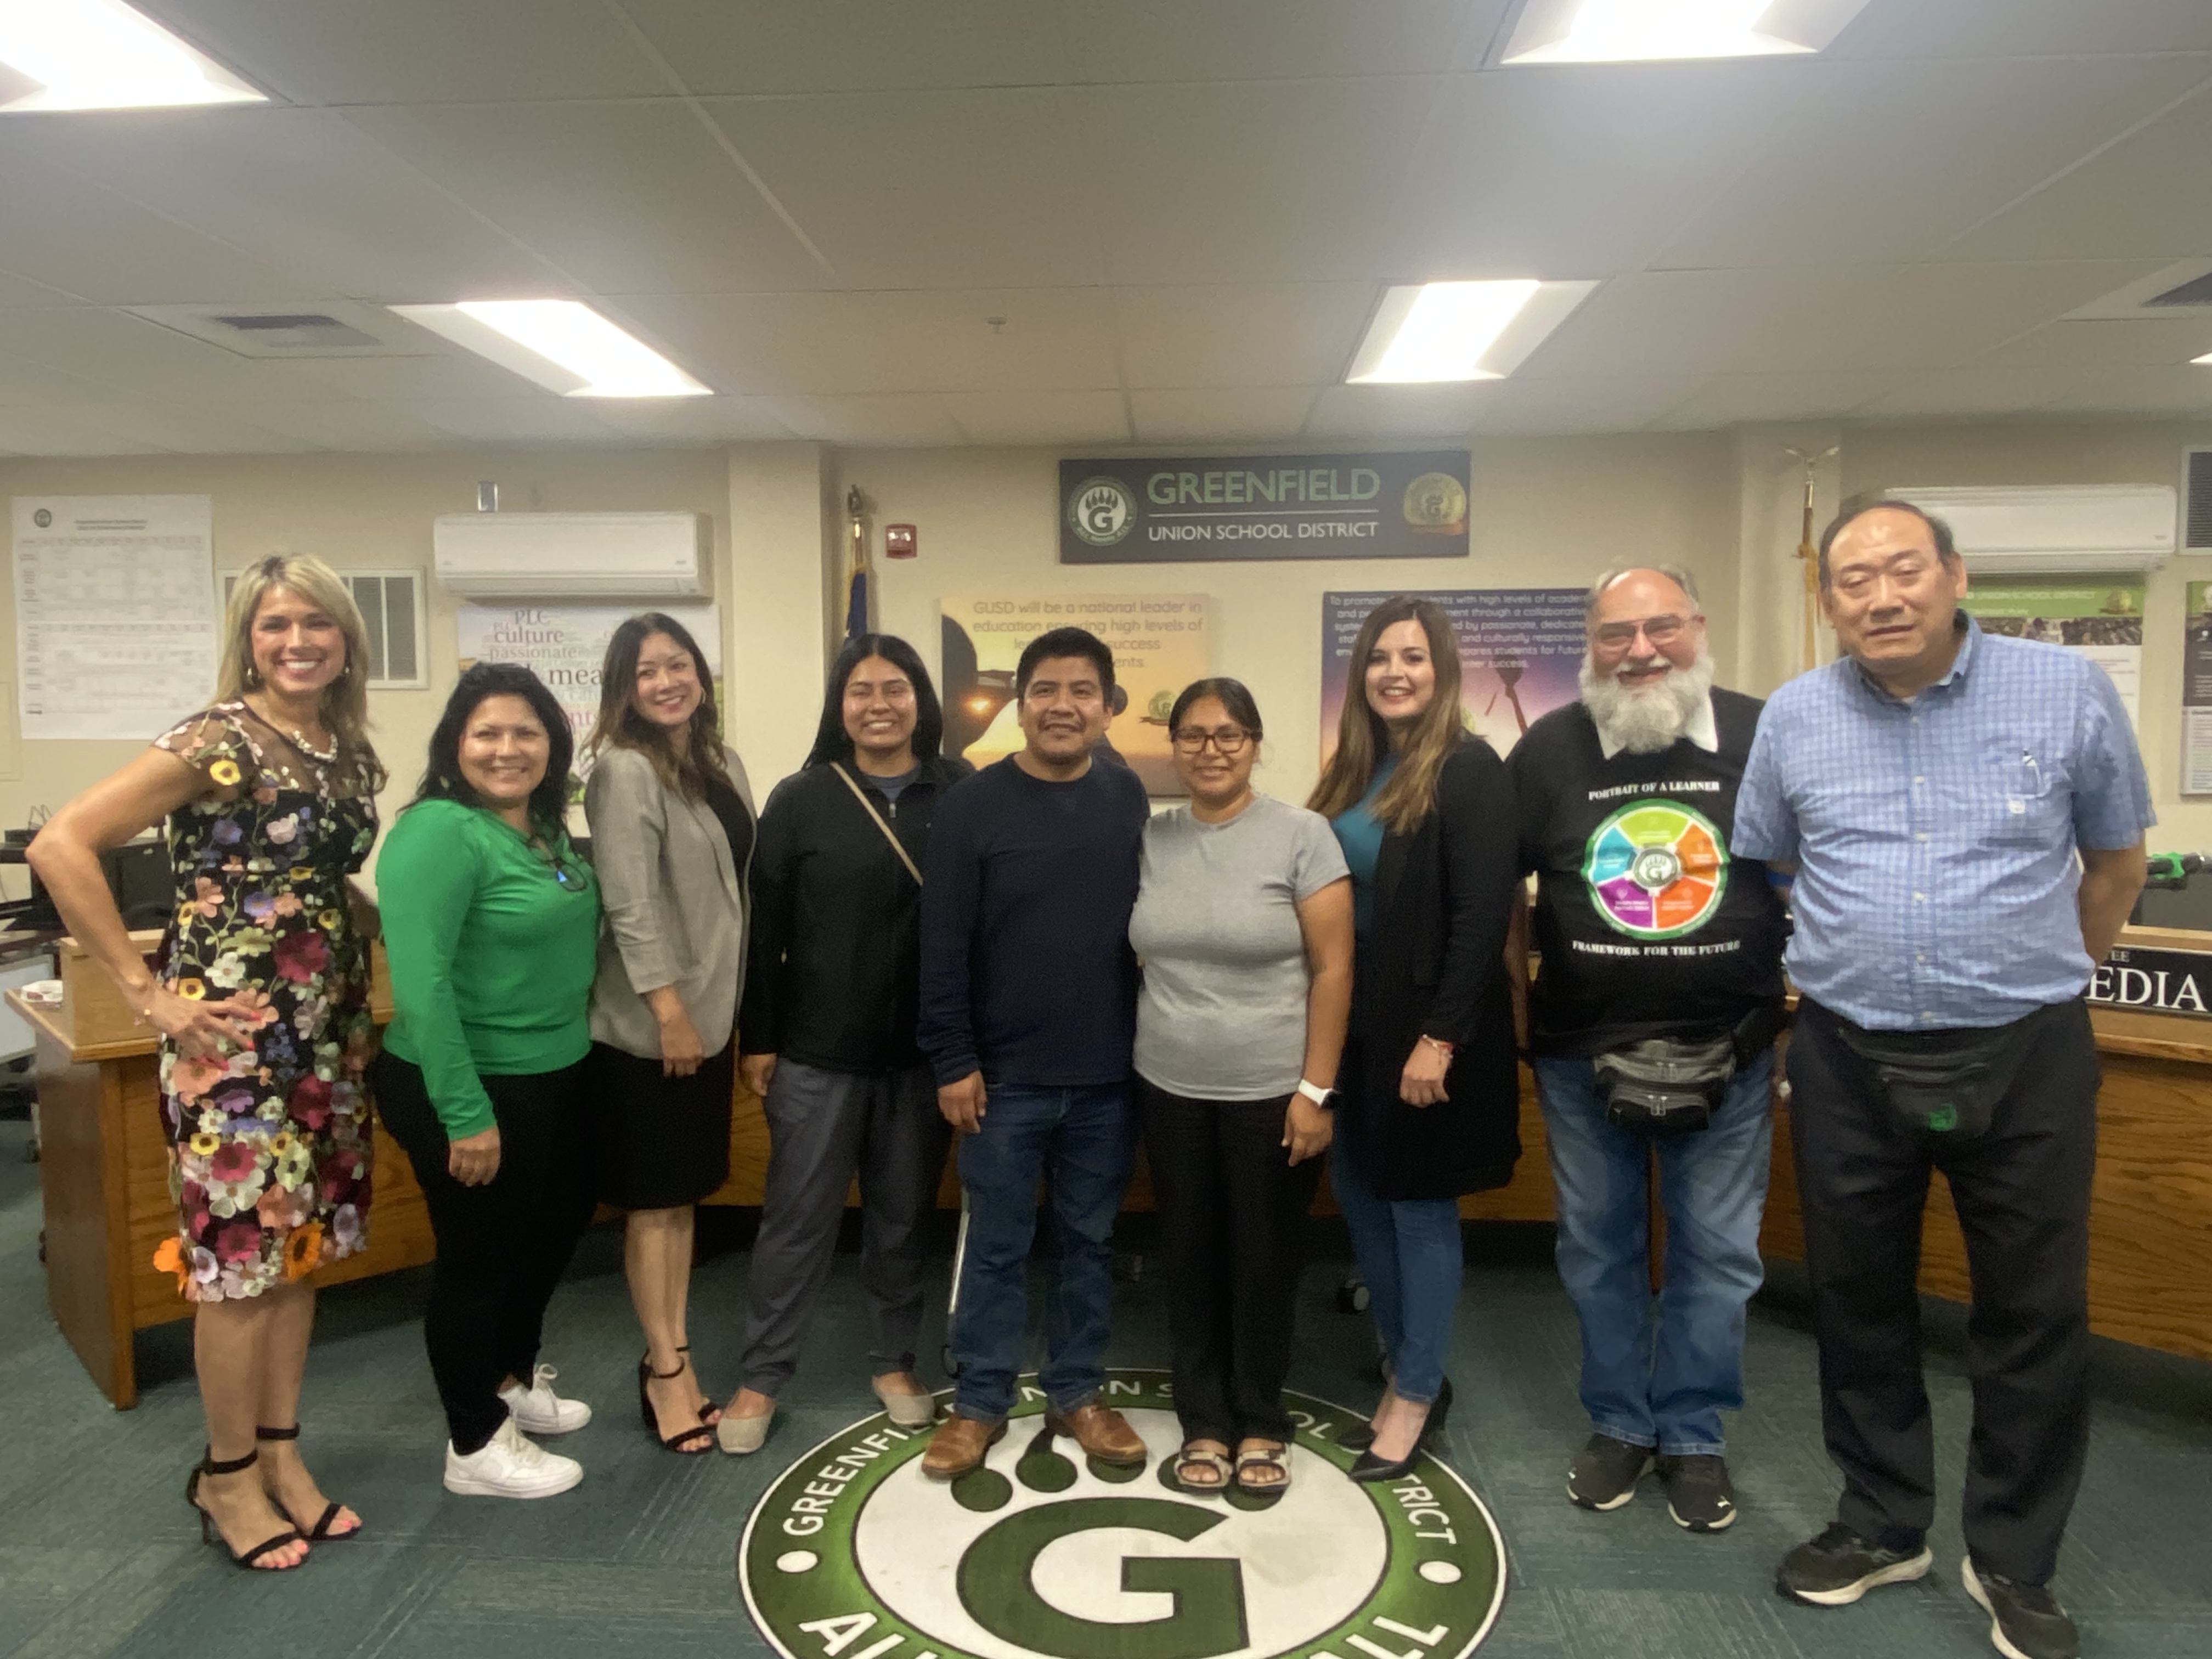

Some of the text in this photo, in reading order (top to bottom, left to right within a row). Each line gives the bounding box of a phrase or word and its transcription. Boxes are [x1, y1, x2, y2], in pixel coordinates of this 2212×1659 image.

[1147, 468, 1381, 505] GREENFIELD
[1148, 521, 1380, 541] UNION SCHOOL DISTRICT
[973, 600, 1202, 614] GUSD will be a national leader in
[515, 609, 551, 625] PLC
[973, 620, 1042, 632] education
[1111, 619, 1141, 635] high
[1145, 619, 1185, 631] levels
[1188, 617, 1204, 631] of
[494, 626, 565, 644] culture
[489, 645, 577, 663] passionate
[1588, 781, 1720, 801] PORTRAIT OF A LEARNER
[1572, 940, 1741, 956] FRAMEWORK FOR THE FUTURE
[783, 1421, 935, 1536] GREENFI
[956, 1497, 1250, 1659] G
